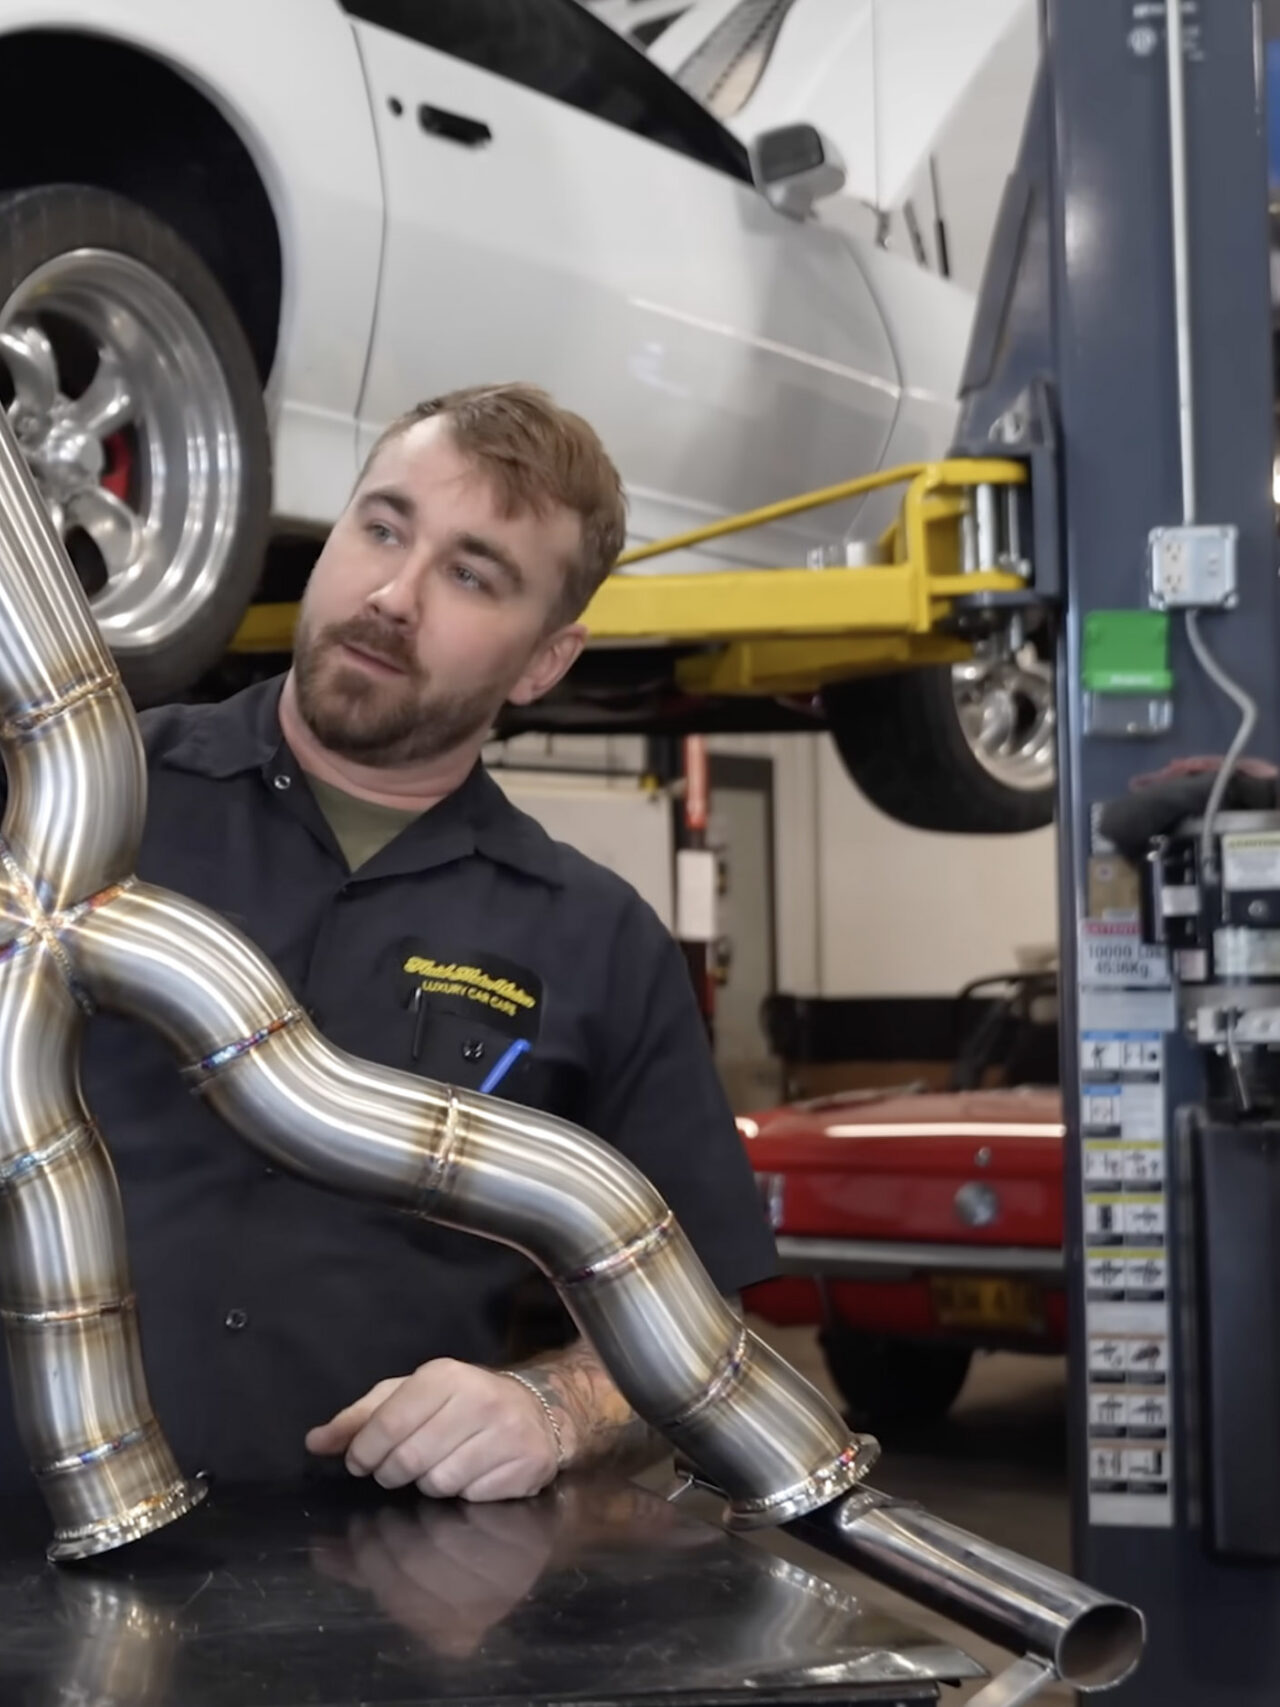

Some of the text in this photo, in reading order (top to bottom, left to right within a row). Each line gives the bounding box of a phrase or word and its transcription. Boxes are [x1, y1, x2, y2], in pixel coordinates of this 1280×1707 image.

[1089, 944, 1132, 959] 10000
[422, 980, 518, 1017] LUXURY CAR CARE
